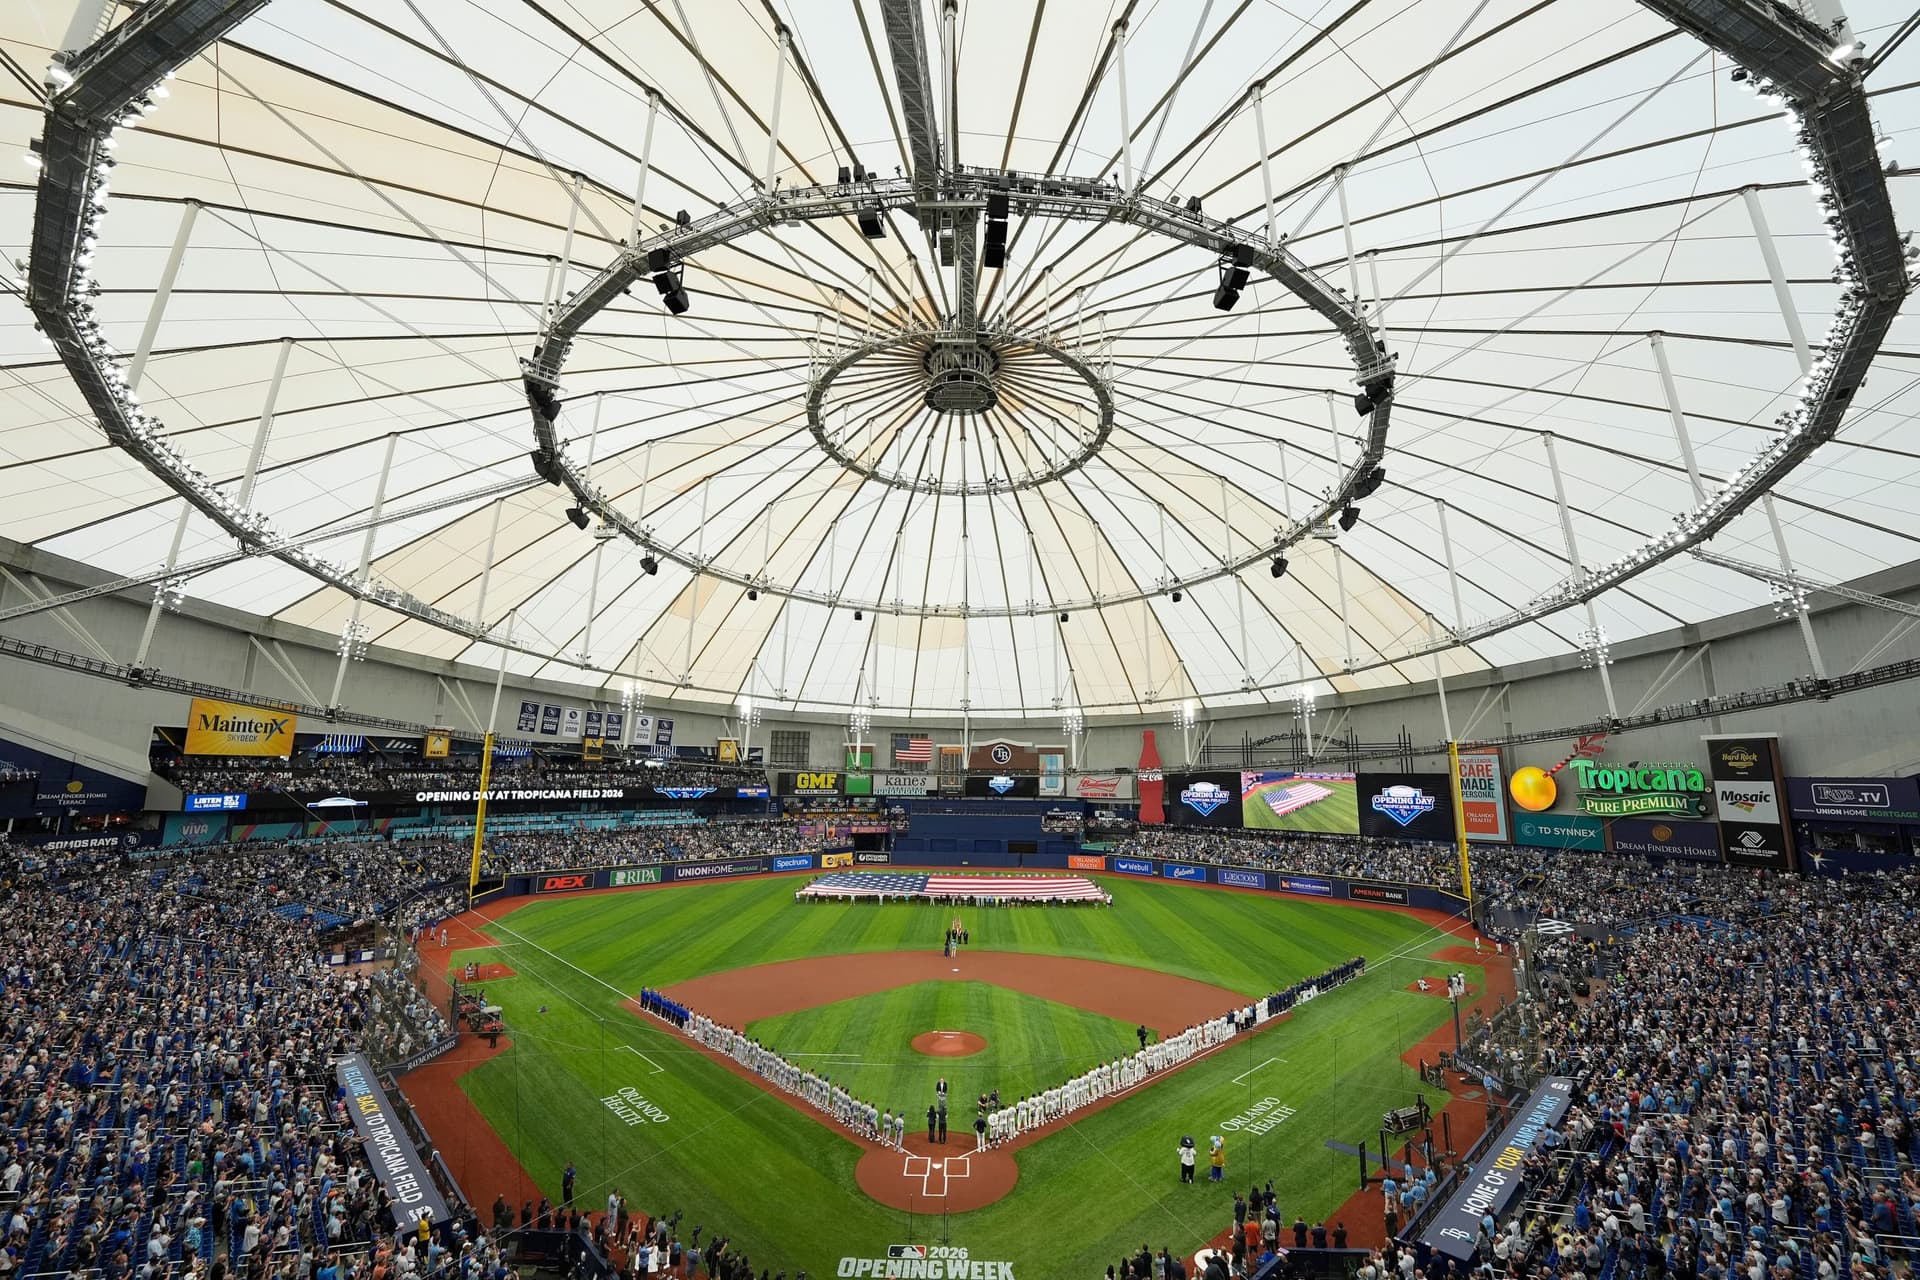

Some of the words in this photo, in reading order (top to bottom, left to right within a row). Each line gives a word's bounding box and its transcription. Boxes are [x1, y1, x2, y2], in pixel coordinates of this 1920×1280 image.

[198, 713, 289, 741] MaintenX
[1460, 764, 1493, 777] CARE
[1570, 760, 1704, 794] Tropicana
[797, 772, 838, 788] GMF
[1460, 778, 1495, 790] MADE
[416, 791, 470, 801] OPENING
[472, 791, 494, 800] DAY
[496, 790, 510, 800] AT
[512, 790, 570, 800] TROPICANA
[573, 790, 600, 798] FIELD
[602, 789, 624, 798] 2026
[1720, 790, 1770, 803] Mosaic
[1586, 800, 1620, 812] PURE
[1622, 798, 1688, 811] PREMIUM
[183, 824, 208, 834] VIVA
[1538, 826, 1551, 834] TD
[1554, 827, 1596, 838] SYNNEX
[90, 837, 118, 847] RAYS
[1616, 841, 1648, 850] DREAM
[1648, 843, 1681, 854] FINDERS
[1684, 846, 1717, 857] HOMES
[678, 868, 708, 877] UNION
[708, 865, 733, 874] HOME
[776, 859, 806, 868] Spectrum
[1128, 862, 1149, 872] Webull
[544, 876, 586, 889] DEX
[626, 870, 656, 883] RIPA
[1224, 872, 1258, 882] LECOM
[1354, 889, 1384, 898] AMERANT
[1386, 892, 1403, 900] BANK
[344, 1065, 370, 1096] WELCOME
[356, 1094, 381, 1116] BACK
[600, 1094, 647, 1126] HEALTH
[618, 1086, 670, 1122] ORLANDO
[365, 1112, 386, 1126] TO
[1220, 1097, 1280, 1130] ORLANDO
[1244, 1104, 1297, 1136] HEALTH
[1540, 1104, 1558, 1125] BAY
[1510, 1122, 1550, 1148] TAMPA
[370, 1124, 409, 1176] TROPICANA
[1495, 1146, 1526, 1170] YOUR
[1484, 1169, 1508, 1187] OF
[392, 1173, 424, 1204] FIELD
[1460, 1183, 1500, 1217] HOME
[929, 1246, 968, 1260] 2026
[837, 1258, 943, 1279] OPENING
[946, 1260, 1016, 1280] WEEK
